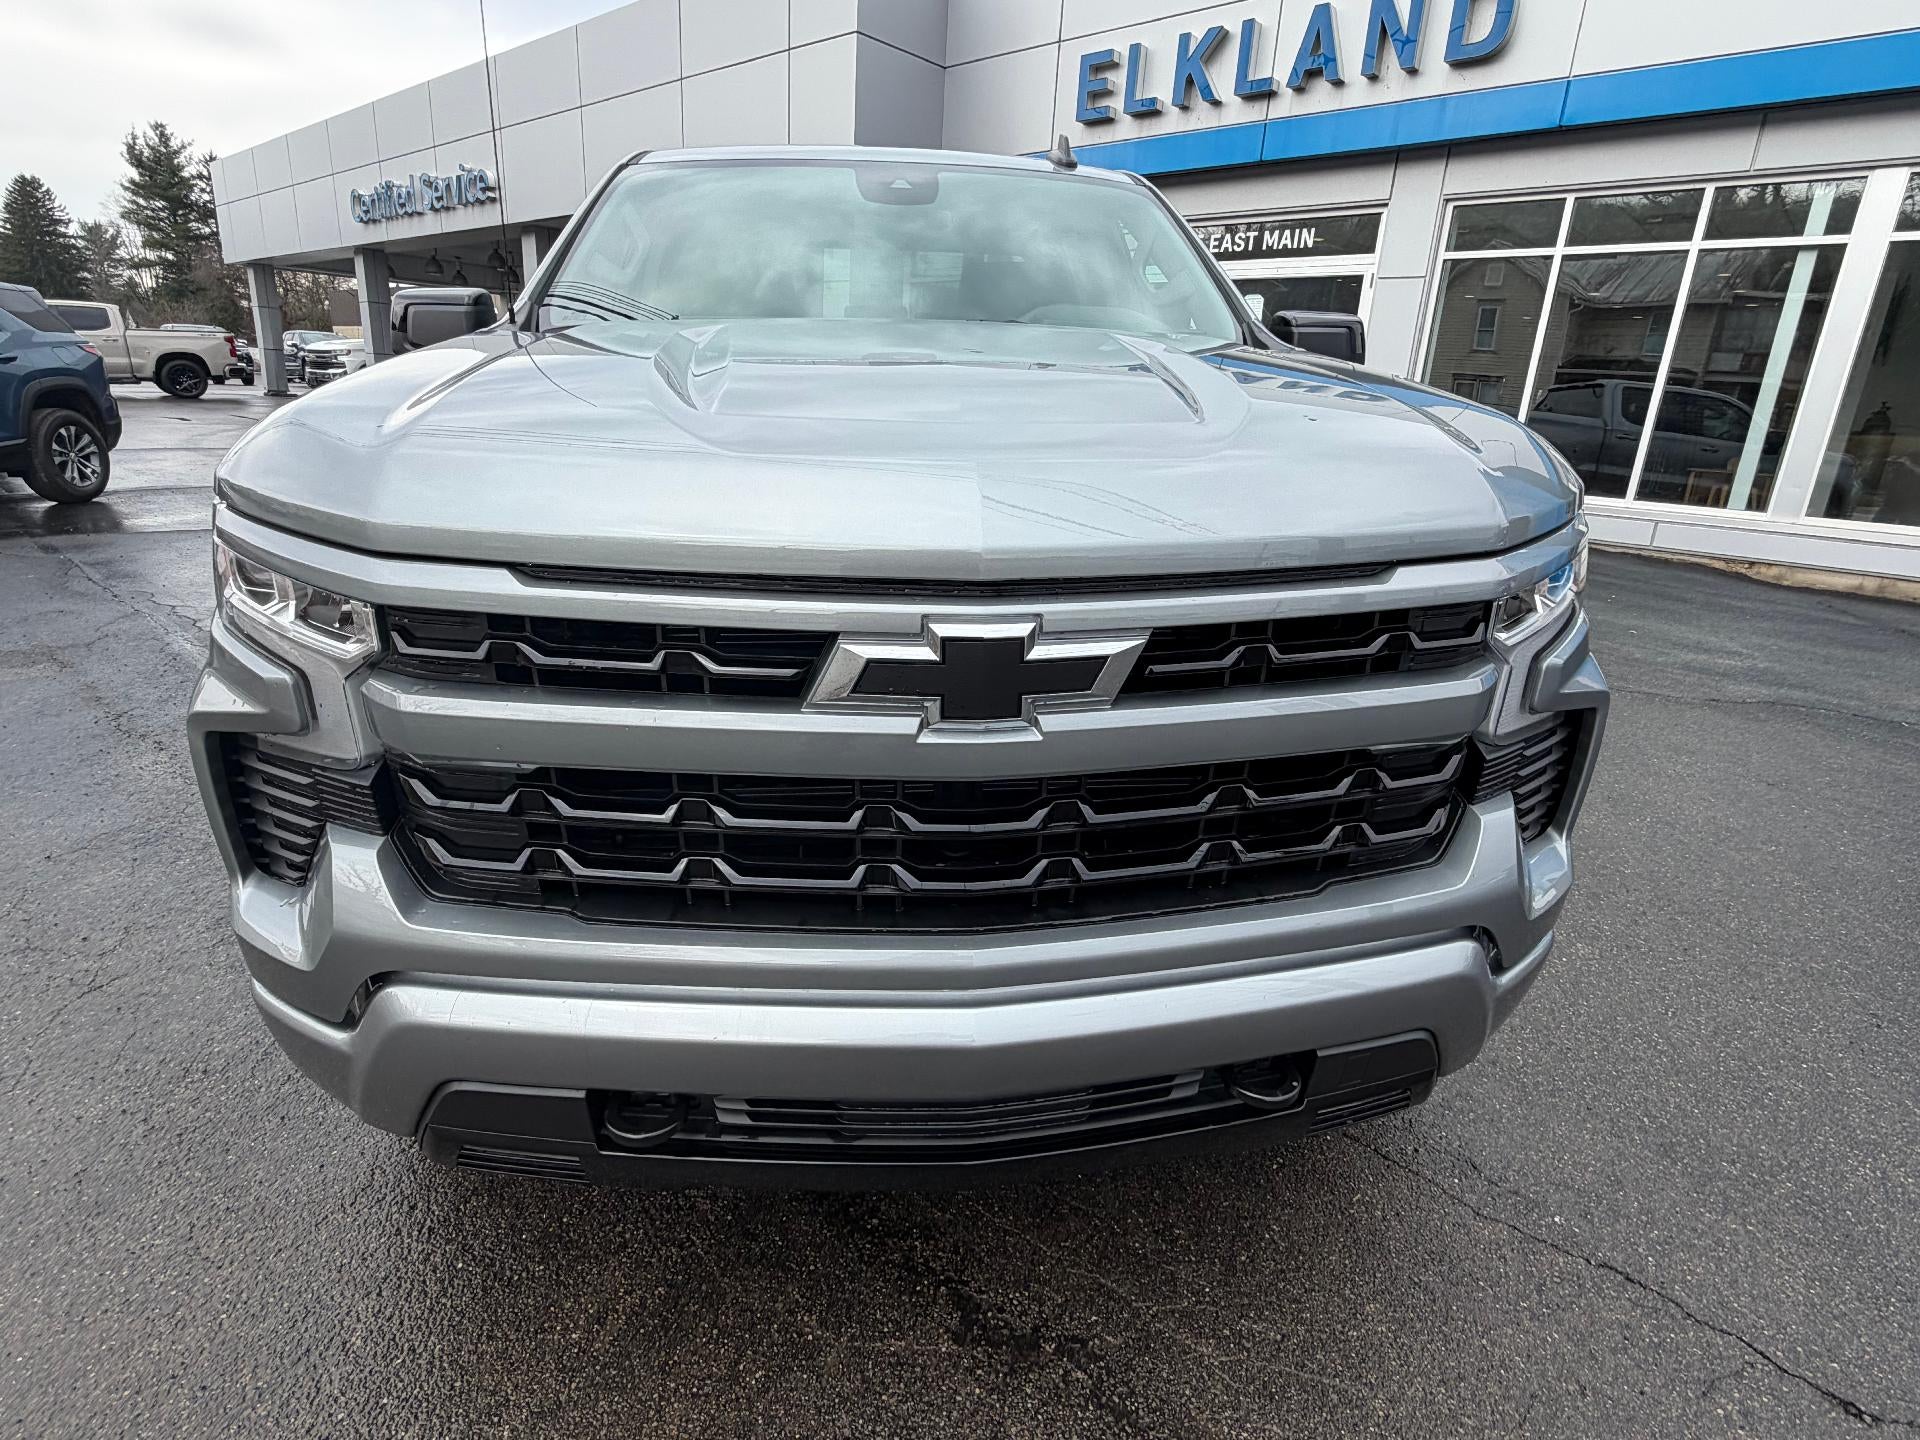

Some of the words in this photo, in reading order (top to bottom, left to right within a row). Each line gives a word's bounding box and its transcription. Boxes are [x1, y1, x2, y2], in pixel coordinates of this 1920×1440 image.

[1075, 0, 1518, 125] ELKLAND
[350, 174, 417, 223] Certified
[419, 163, 494, 210] Service
[1208, 230, 1259, 253] EAST
[1262, 227, 1316, 251] MAIN
